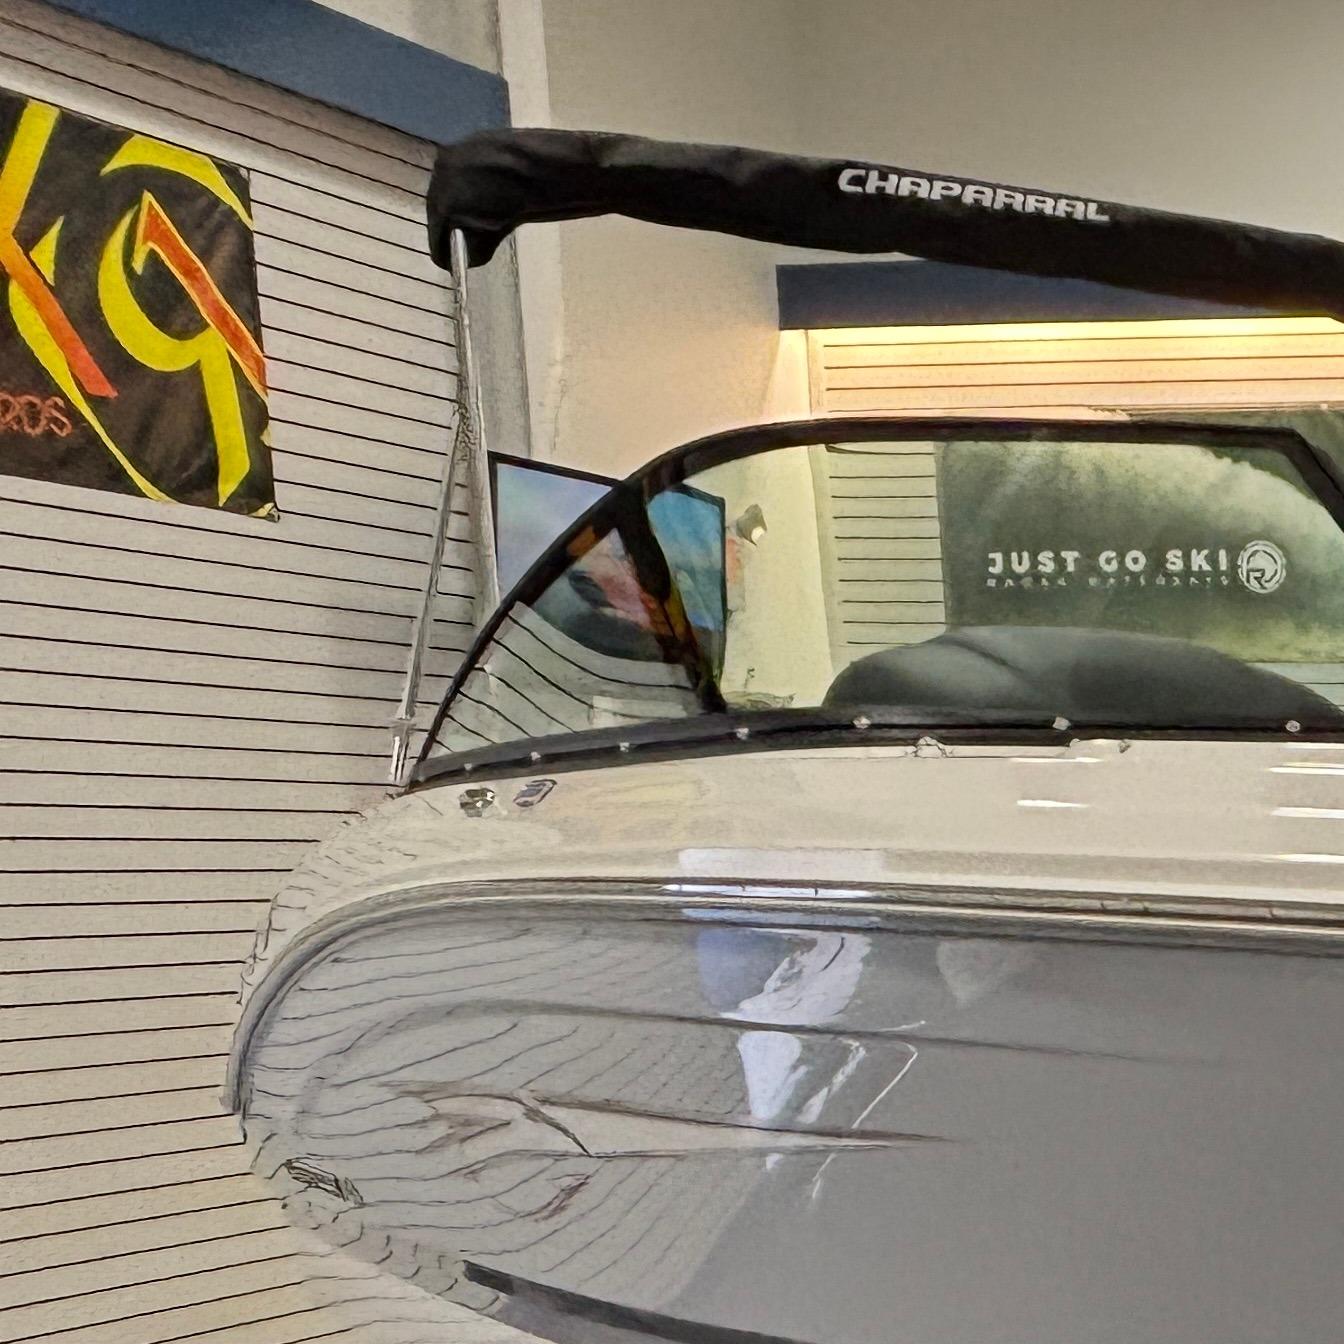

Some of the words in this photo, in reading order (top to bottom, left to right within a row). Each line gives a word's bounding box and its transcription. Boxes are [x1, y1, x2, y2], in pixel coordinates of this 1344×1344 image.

[838, 168, 1110, 221] CHAPARRAL
[987, 550, 1080, 574] JUST
[1099, 550, 1147, 572] GO
[1166, 549, 1227, 572] SKI
